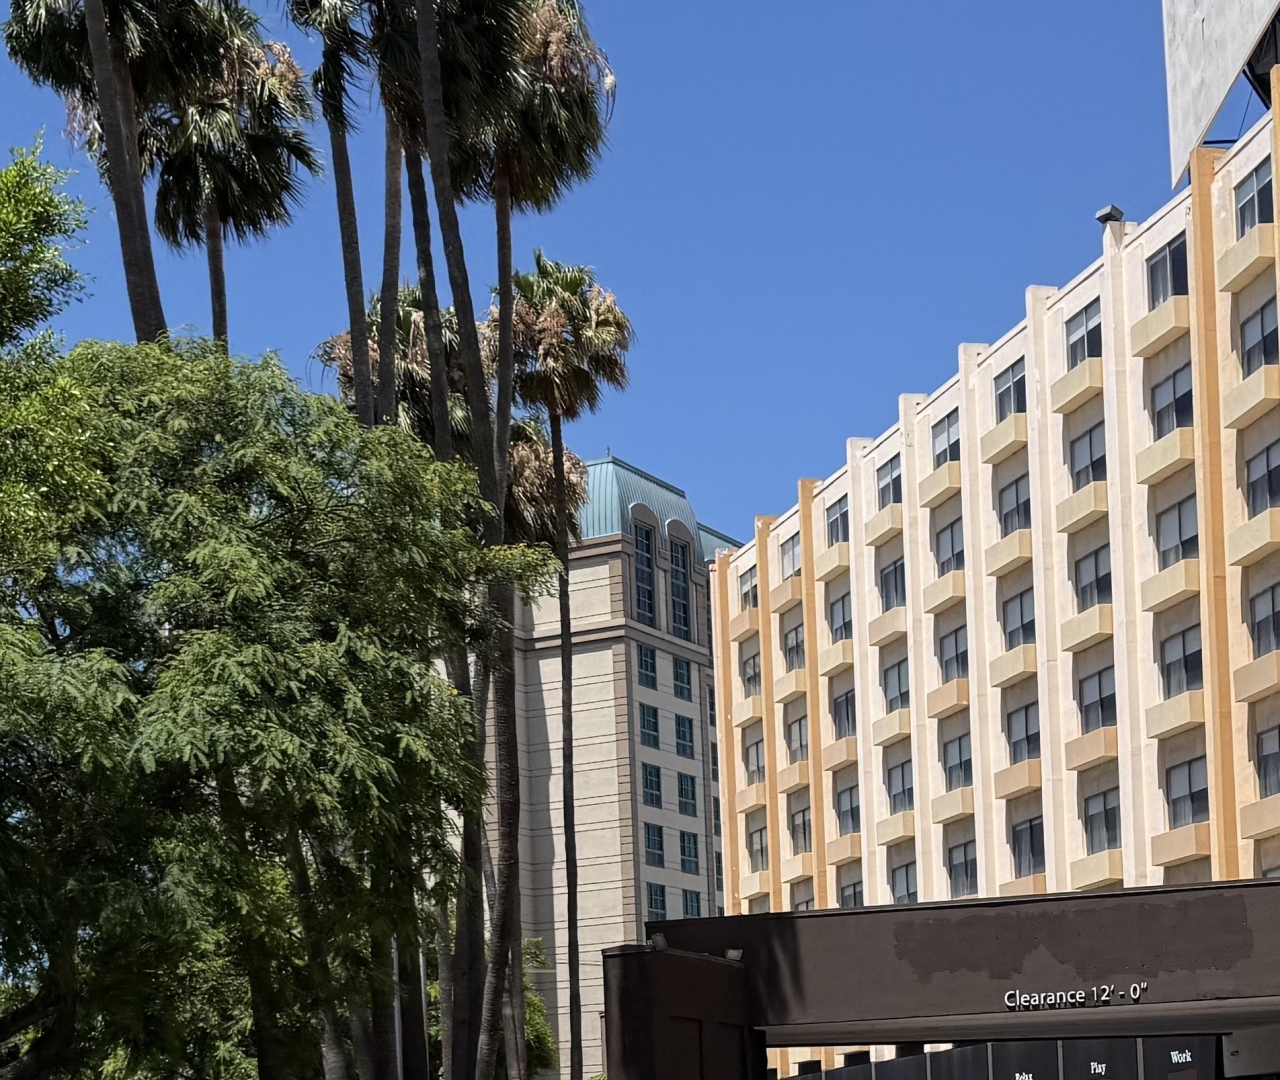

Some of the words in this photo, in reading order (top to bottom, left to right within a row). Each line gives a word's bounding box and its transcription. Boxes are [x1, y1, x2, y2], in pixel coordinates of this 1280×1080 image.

[1005, 990, 1085, 1006] Clearance
[1091, 985, 1114, 1001] 12'
[1170, 1050, 1192, 1063] Work
[1090, 1062, 1106, 1075] Play
